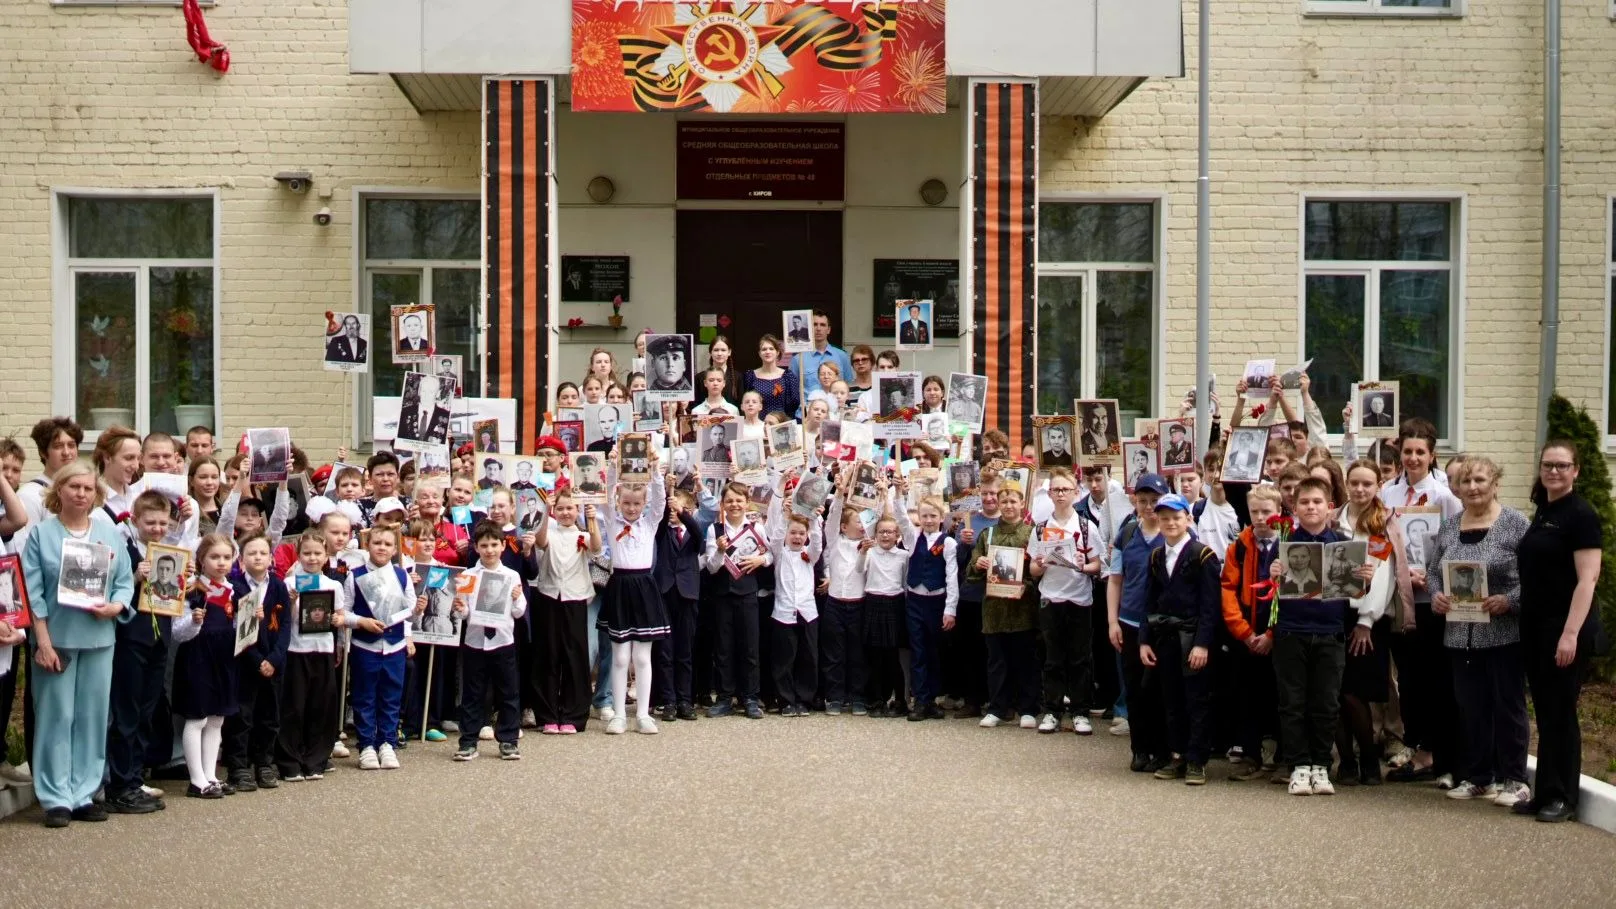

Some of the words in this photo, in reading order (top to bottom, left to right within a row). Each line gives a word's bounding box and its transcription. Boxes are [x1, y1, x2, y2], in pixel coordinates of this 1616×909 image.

[686, 15, 750, 74] ОТЕЧЕСТВЕННАЯ
[682, 141, 717, 149] СРЕДНЯЯ
[708, 157, 714, 165] С
[769, 157, 813, 165] ИЗУЧЕНИЕМ
[705, 173, 751, 181] ОТДЕЛЬНЫХ
